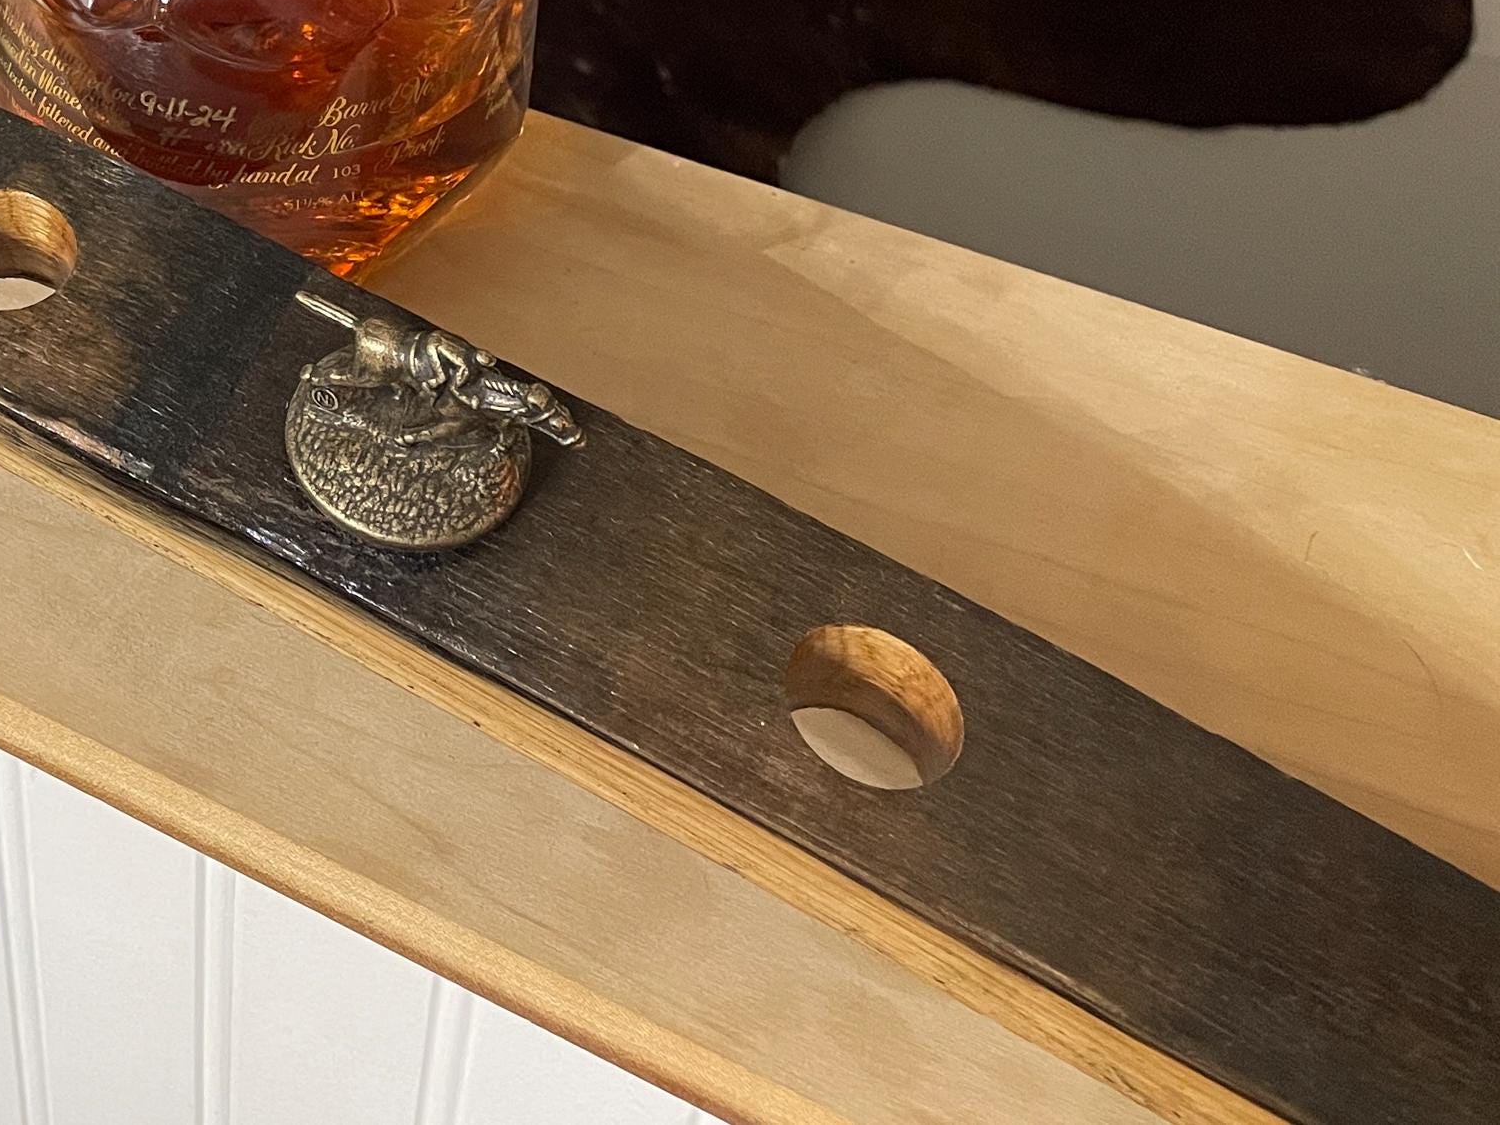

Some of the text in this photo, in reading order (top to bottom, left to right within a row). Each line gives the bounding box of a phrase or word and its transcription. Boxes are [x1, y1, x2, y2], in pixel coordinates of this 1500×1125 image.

[35, 95, 94, 150] filtered
[140, 90, 237, 134] 9-11-24
[312, 80, 403, 129] Barrel
[248, 131, 317, 163] Rick
[231, 162, 297, 187] hand
[295, 164, 320, 185] at
[333, 164, 361, 179] 103
